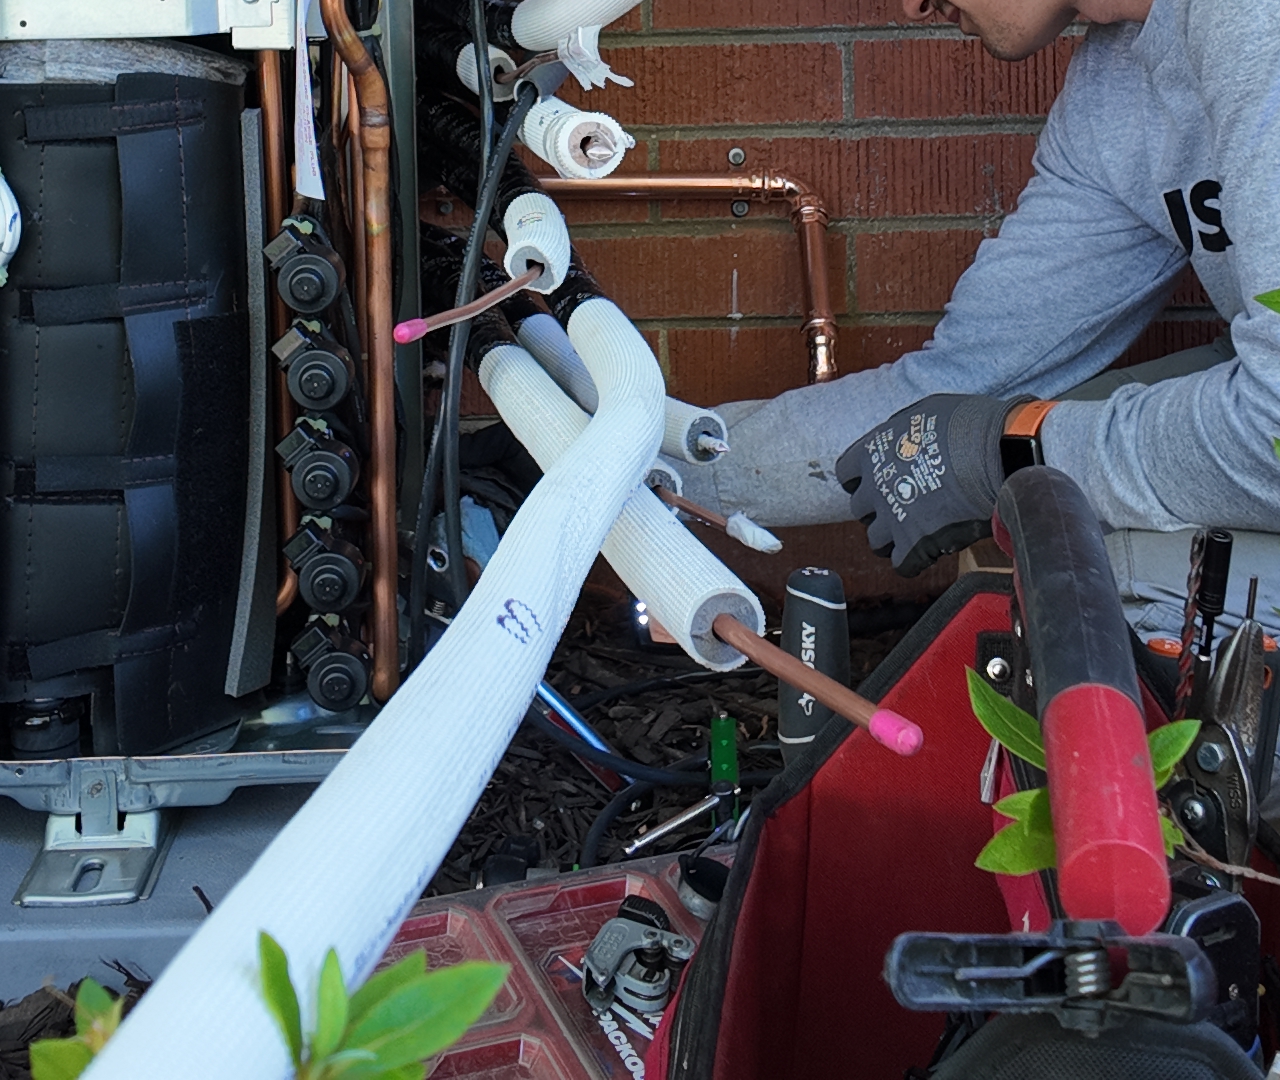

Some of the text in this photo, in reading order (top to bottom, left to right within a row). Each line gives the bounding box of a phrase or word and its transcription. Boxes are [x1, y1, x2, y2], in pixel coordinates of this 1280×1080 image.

[864, 439, 907, 523] MaxiFlex
[801, 621, 816, 671] SKY
[1227, 771, 1242, 811] WISS
